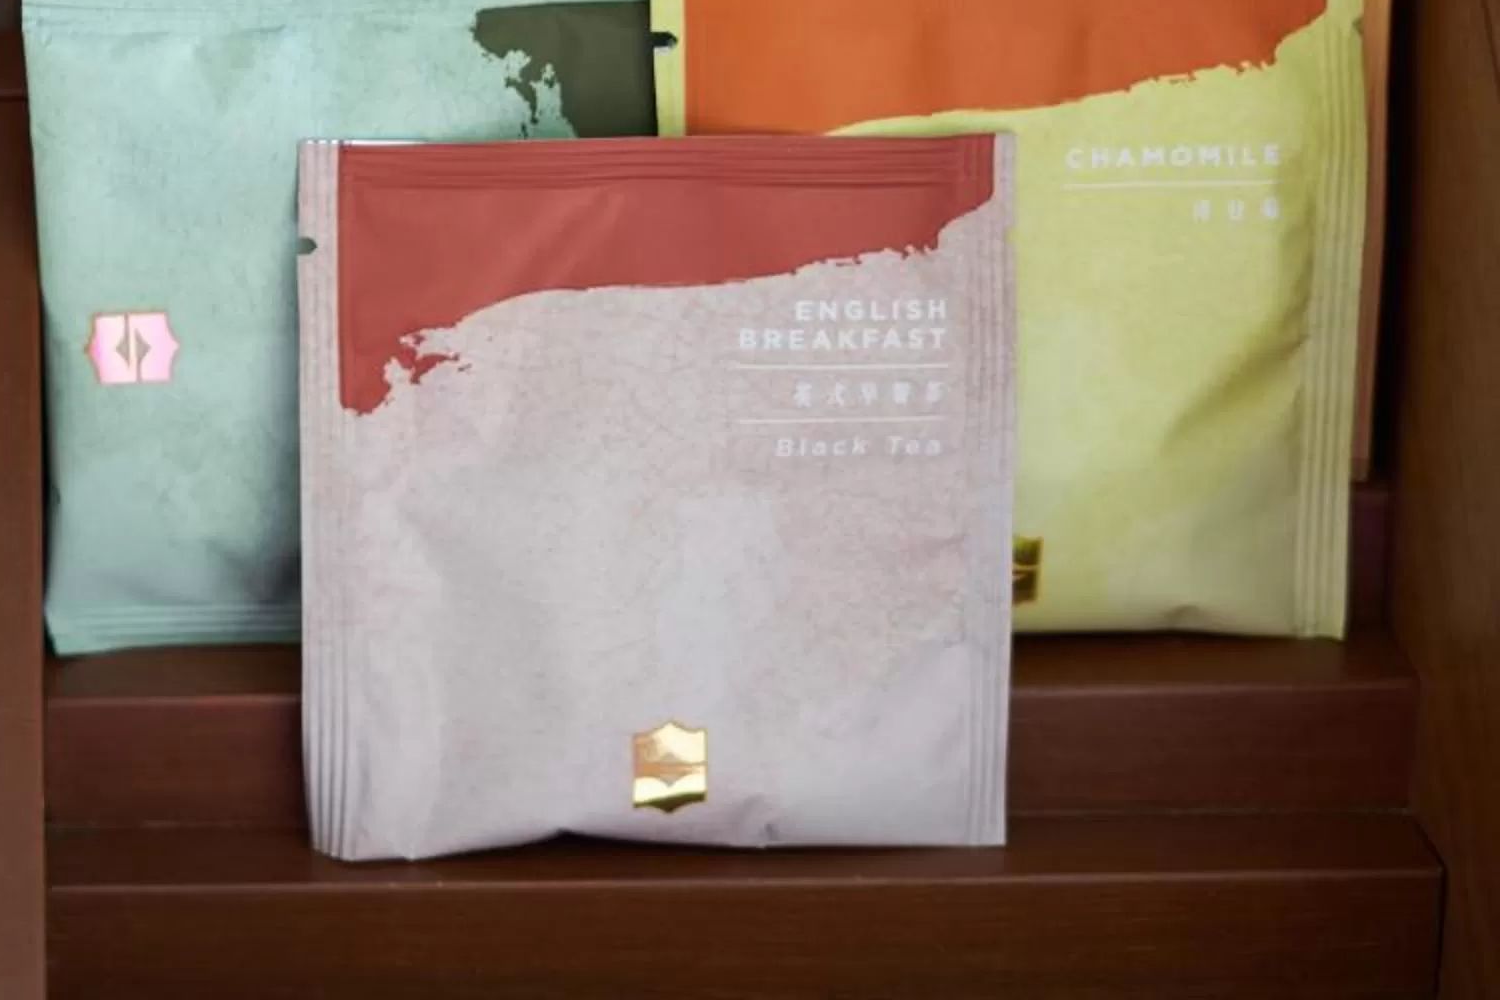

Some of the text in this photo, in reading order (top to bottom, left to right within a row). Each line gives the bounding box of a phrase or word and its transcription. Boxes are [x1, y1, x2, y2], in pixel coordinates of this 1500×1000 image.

[1065, 142, 1282, 171] CHAMOMILE
[795, 299, 947, 322] ENGLISH
[738, 327, 947, 351] BREAKFAST
[774, 435, 942, 458] Black Tea
